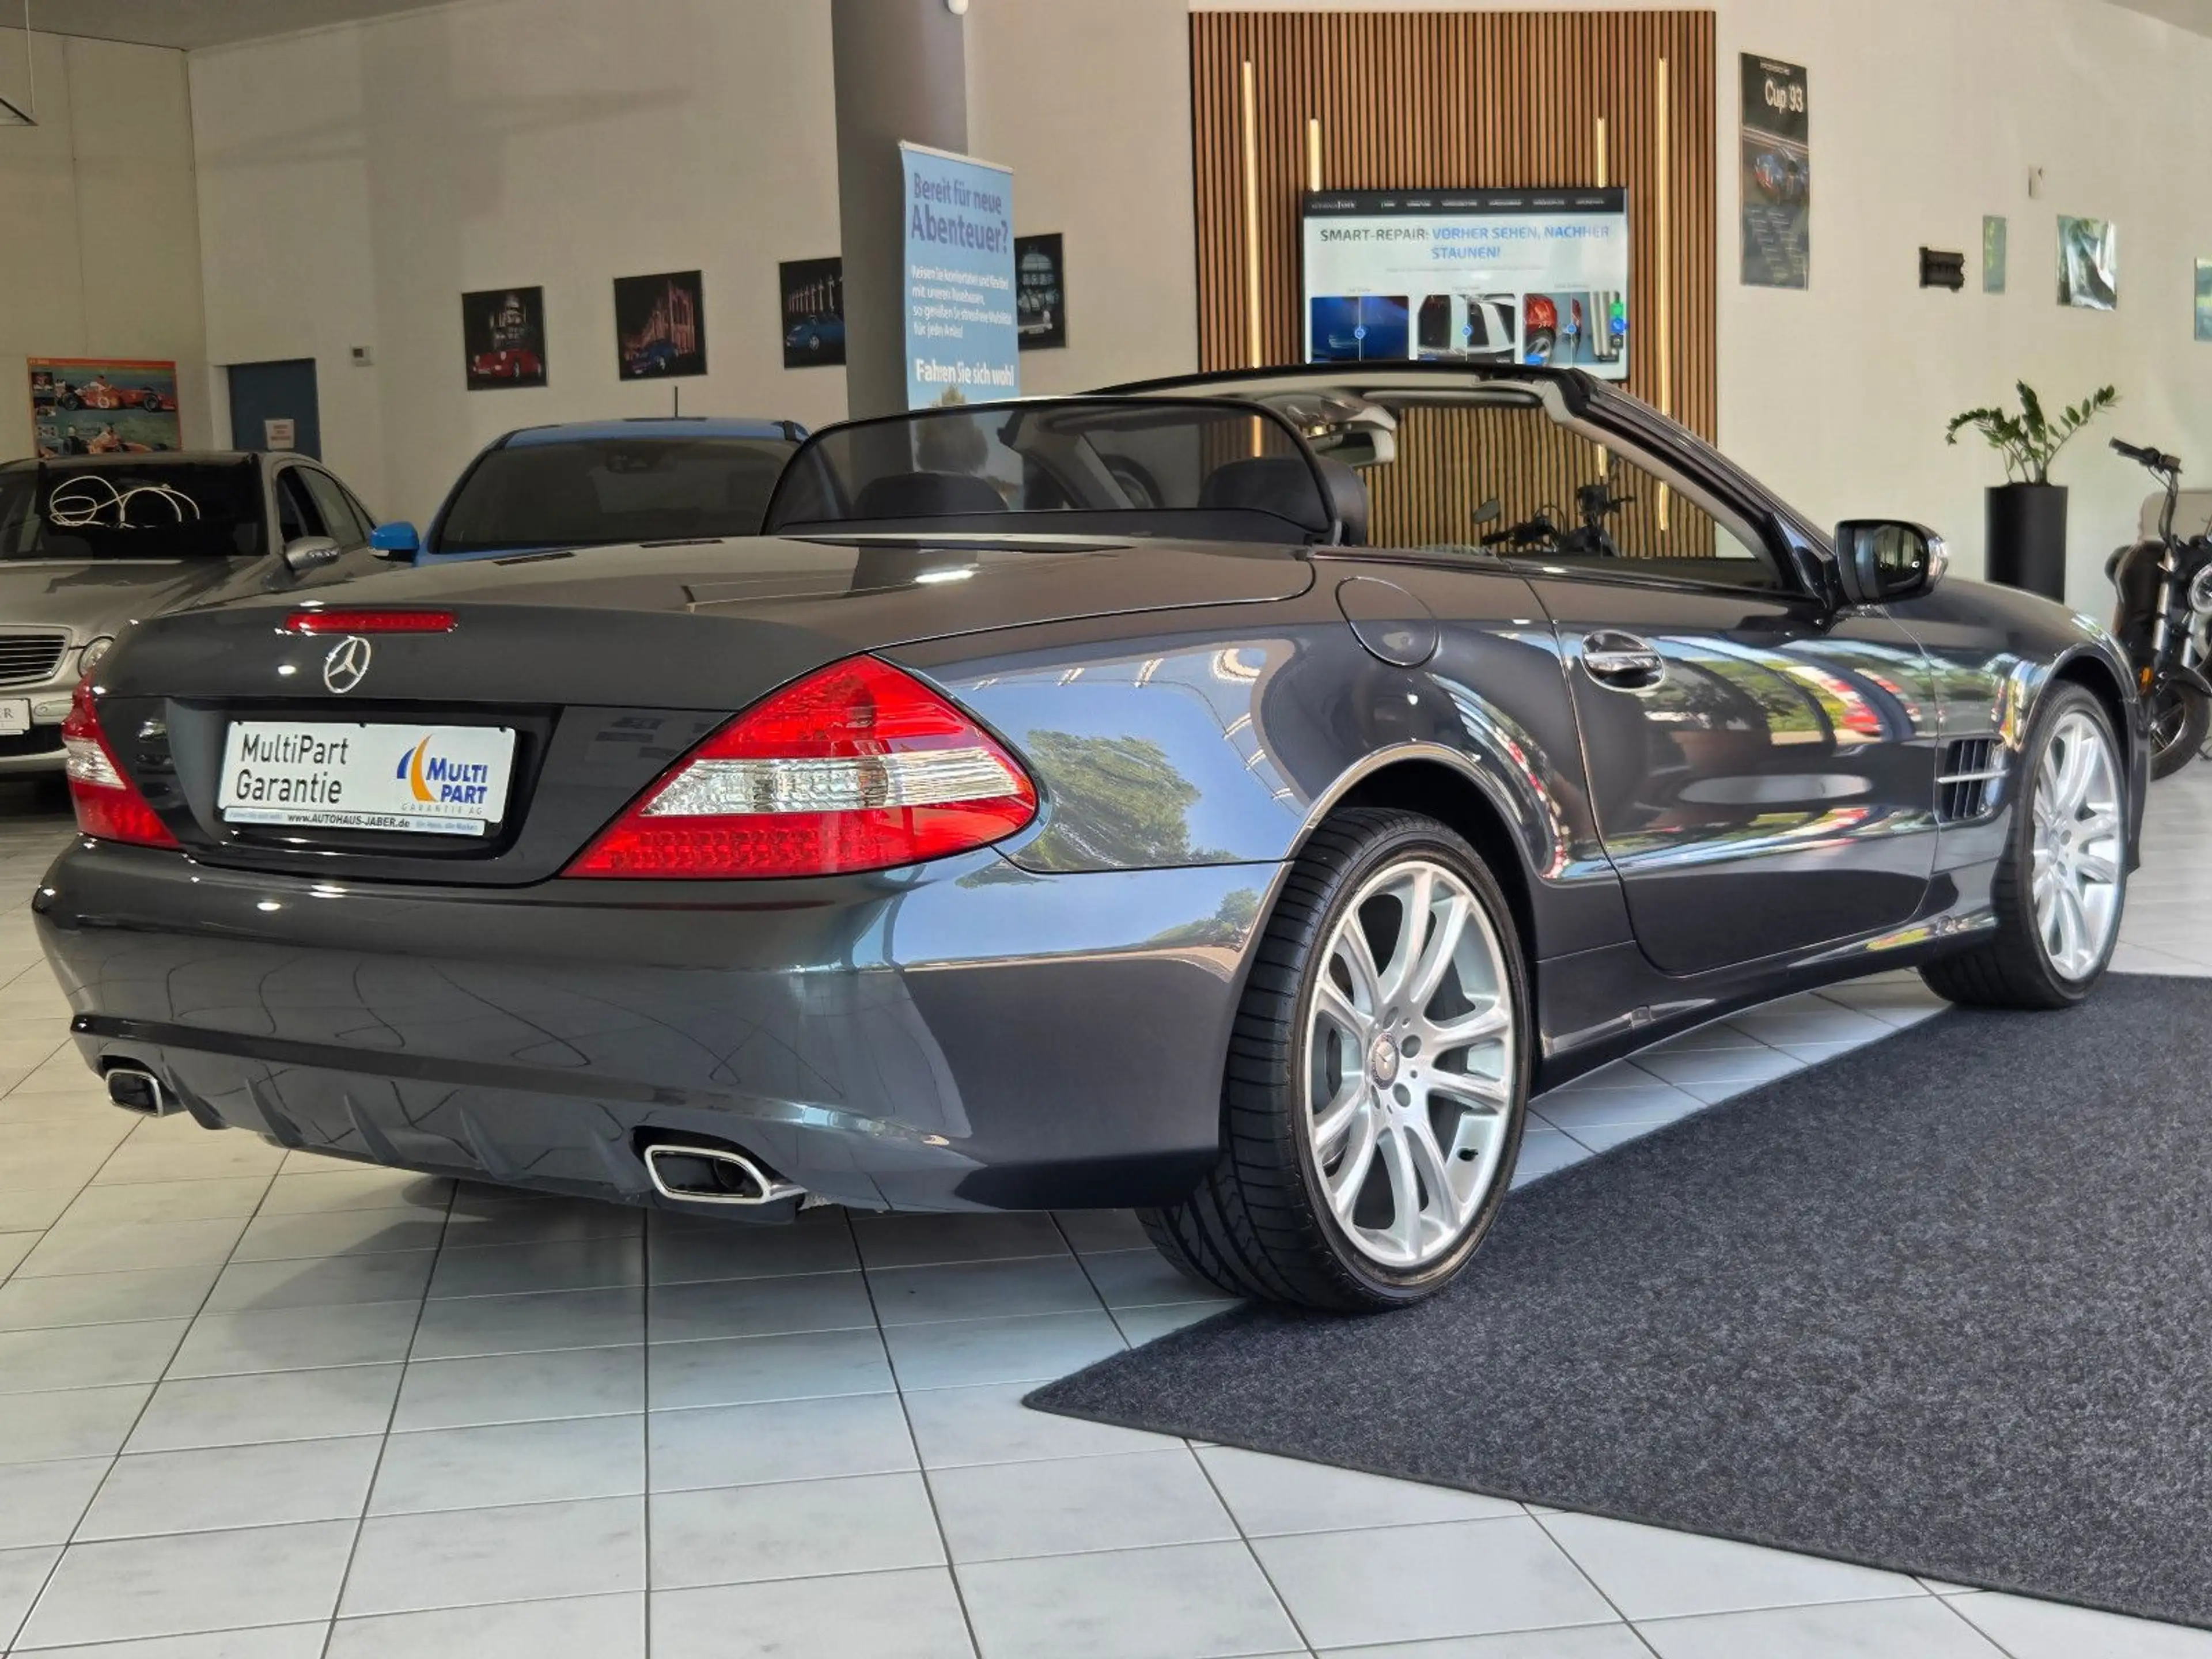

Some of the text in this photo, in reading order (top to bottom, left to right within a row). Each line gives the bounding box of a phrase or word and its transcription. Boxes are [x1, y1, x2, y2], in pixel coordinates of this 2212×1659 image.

[1765, 79, 1786, 114] Cup
[914, 172, 1002, 215] Bereit für neue
[911, 204, 1008, 254] Abenteuer?
[1320, 225, 1609, 242] SMART-REPAIR: VORHER SEHEN, NACHHER
[1431, 245, 1501, 260] STAUNEN!
[916, 358, 1014, 387] Fahren Sie sich wohl
[241, 733, 349, 765] MultiPart
[236, 768, 342, 804] Garantie
[441, 784, 488, 804] PART
[287, 813, 410, 828] www.AUTOHAUS-JABER.de
[401, 802, 483, 815] GARANTIE AG
